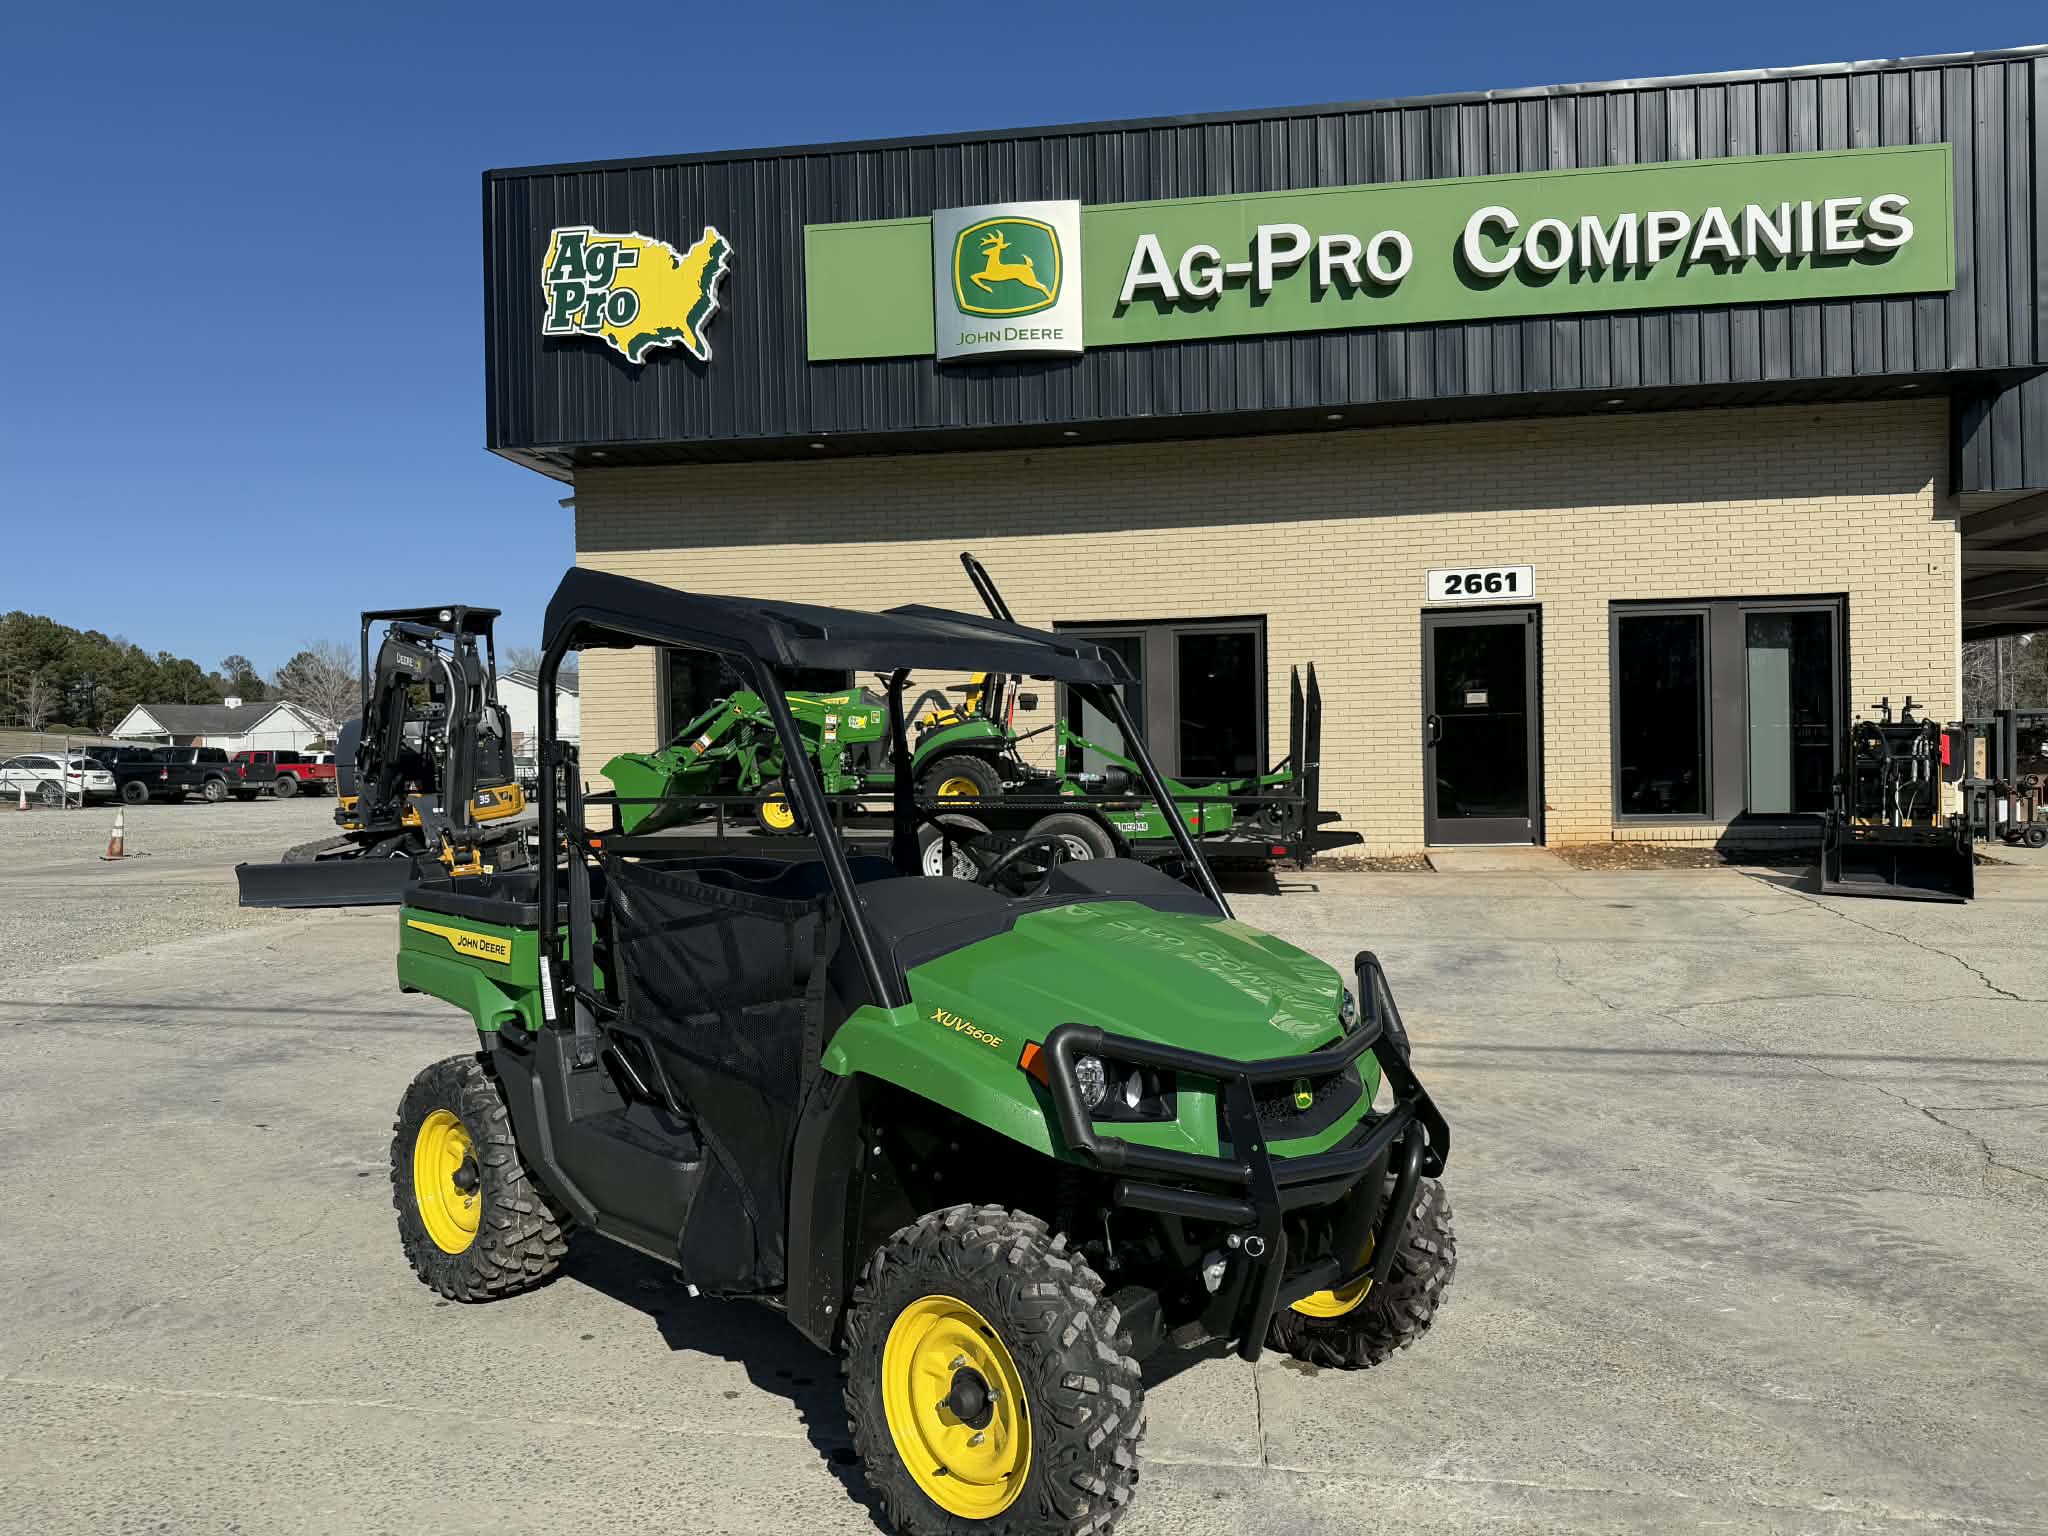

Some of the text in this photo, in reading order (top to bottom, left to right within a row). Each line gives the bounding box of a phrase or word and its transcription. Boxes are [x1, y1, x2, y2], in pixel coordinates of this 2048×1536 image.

[1119, 193, 1914, 305] AG-PRO COMPANIES
[547, 282, 639, 330] Pro
[956, 328, 1064, 345] JOHN DEERE
[1445, 572, 1517, 595] 2661
[479, 794, 490, 805] 35
[458, 935, 506, 955] JOHN DEERE
[930, 1007, 1003, 1048] XUV560E
